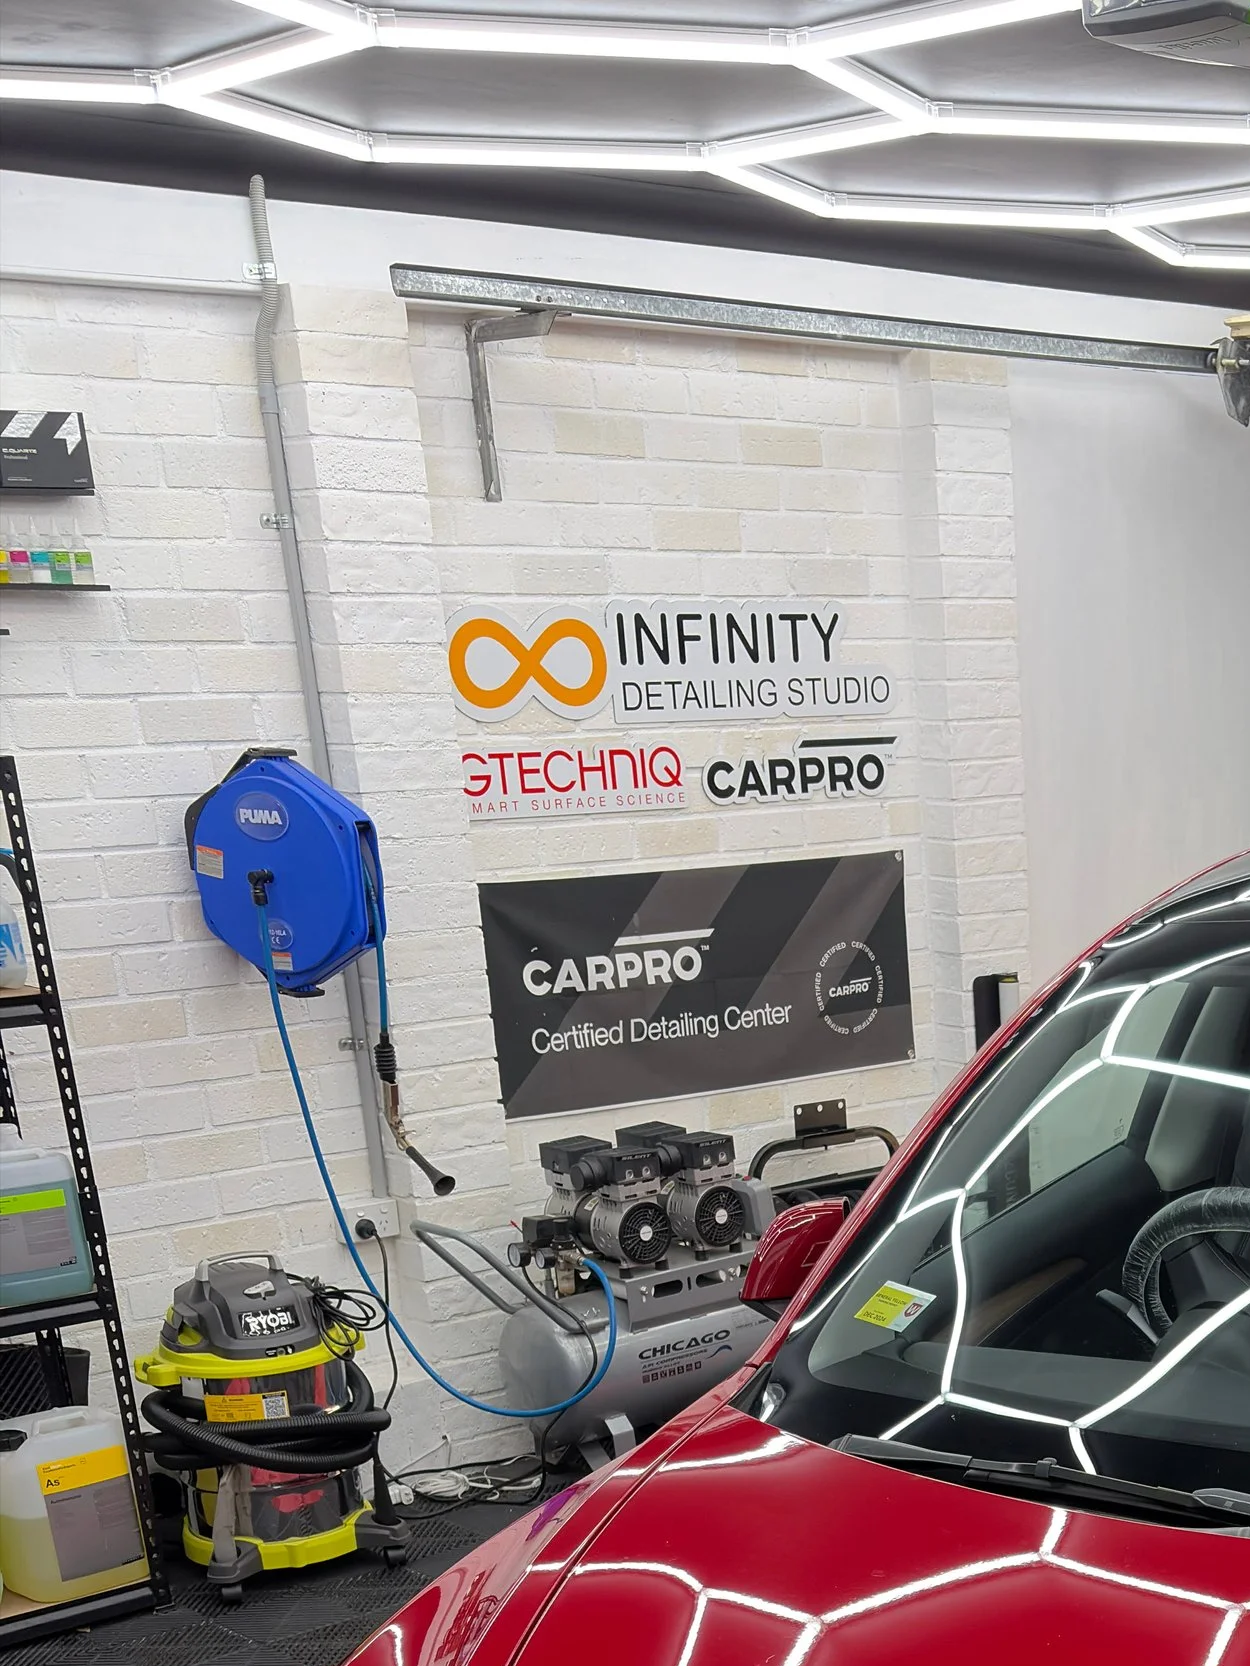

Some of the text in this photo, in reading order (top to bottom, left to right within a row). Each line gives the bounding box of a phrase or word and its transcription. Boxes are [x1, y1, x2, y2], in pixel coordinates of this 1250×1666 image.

[616, 612, 839, 666] INFINITY
[622, 675, 890, 711] DETAILING STUDIO
[462, 746, 684, 797] GTECHNIQ
[706, 753, 885, 799] CARPRO
[471, 792, 687, 814] MART SURFACE SCIENCE
[239, 808, 283, 825] PUMA
[819, 942, 846, 967] CERTIFIED
[851, 940, 876, 962] CERTIFIED
[522, 946, 702, 996] CARPRO
[814, 972, 825, 1011] CERTIFIED
[829, 982, 869, 998] CARPRO
[875, 965, 884, 1004] CERTIFIED
[531, 1002, 792, 1055] Certified Detailing Center
[824, 1015, 850, 1035] CERTIFIED
[853, 1008, 878, 1033] CERTIFIED
[621, 1153, 652, 1161] SILENT
[246, 1311, 292, 1331] RYOBI
[638, 1329, 731, 1360] CHICAGO
[46, 1478, 60, 1488] As
